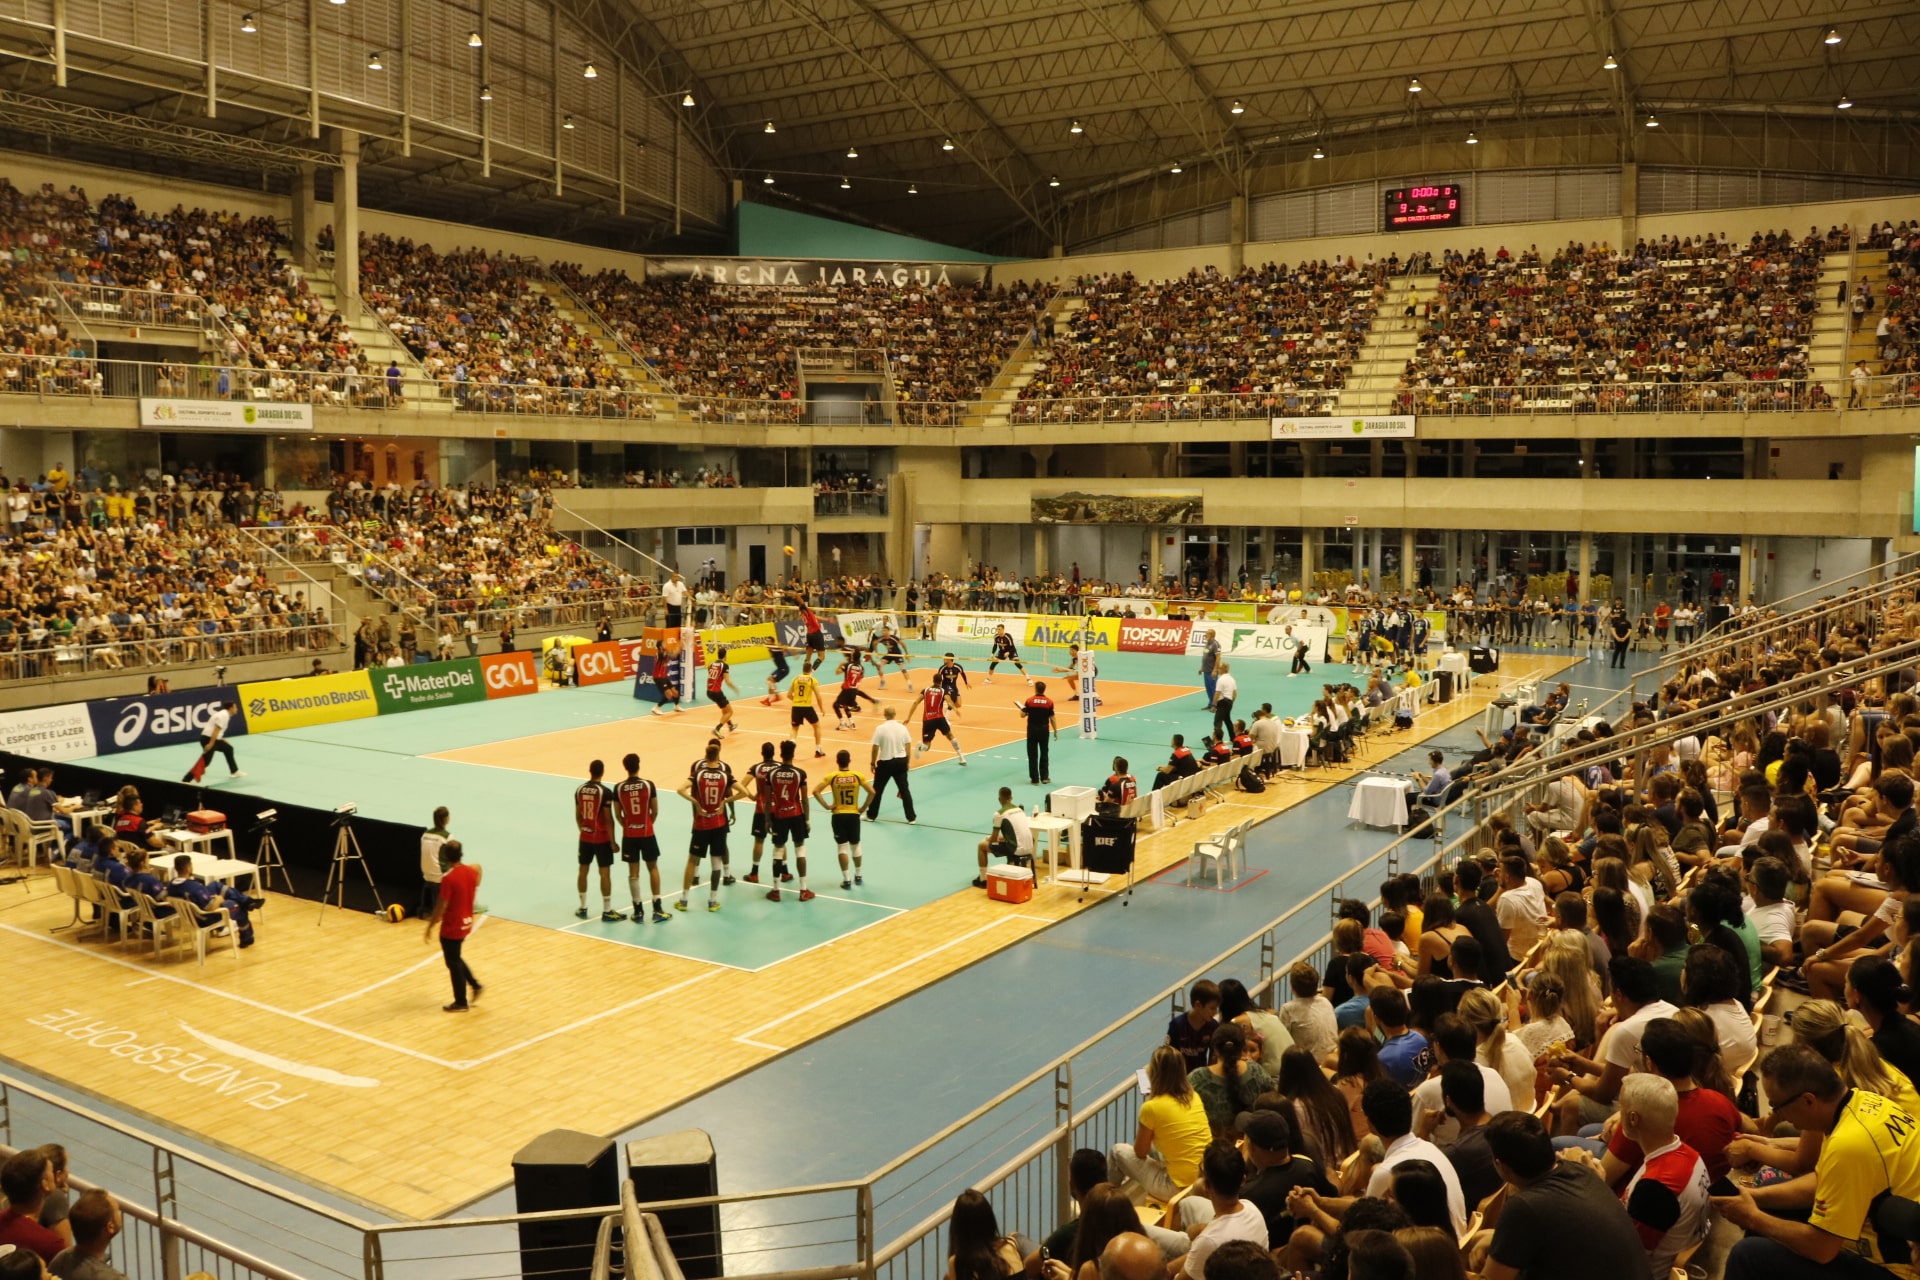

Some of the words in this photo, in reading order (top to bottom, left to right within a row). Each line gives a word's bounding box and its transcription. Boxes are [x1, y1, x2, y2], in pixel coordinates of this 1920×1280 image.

[1400, 203, 1407, 213] 9
[1449, 199, 1456, 209] 8
[1122, 626, 1183, 643] TOPSUN
[580, 650, 622, 677] GOL
[486, 661, 534, 689] GOL
[798, 686, 805, 696] 8
[270, 696, 313, 712] BANCO
[313, 694, 330, 706] DO
[331, 688, 370, 704] BRASIL
[16, 714, 67, 732] Municipal
[6, 731, 48, 745] ESPORTE
[49, 730, 55, 738] E
[57, 726, 85, 738] LAZER
[41, 744, 56, 752] DO
[66, 740, 88, 749] SUL
[581, 787, 598, 795] SESI
[624, 783, 643, 791] SESI
[705, 786, 719, 805] 19
[781, 785, 790, 800] 4
[630, 797, 641, 815] 6
[840, 790, 854, 805] 15
[583, 800, 594, 820] 18
[1095, 836, 1115, 847] KIEF
[26, 1008, 308, 1111] FUNDESPORTE
